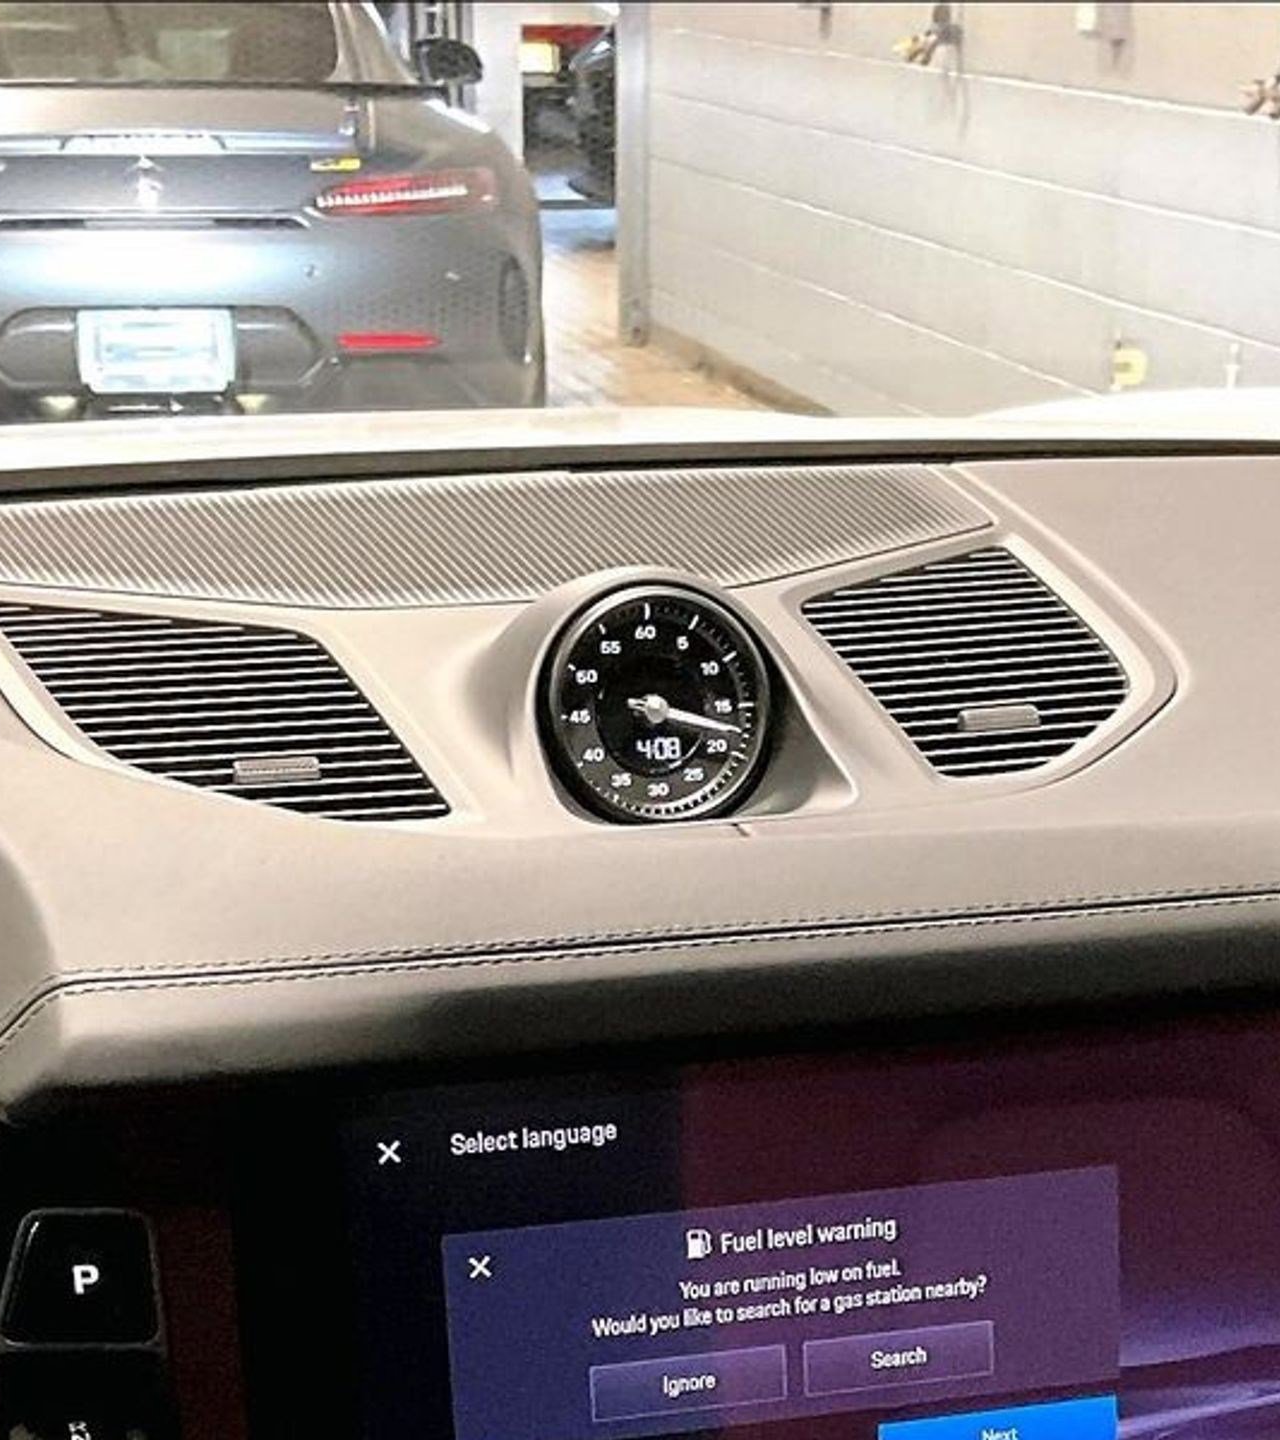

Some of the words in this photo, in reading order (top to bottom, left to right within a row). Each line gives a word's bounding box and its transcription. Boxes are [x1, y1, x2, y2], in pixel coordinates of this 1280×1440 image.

[635, 626, 656, 639] 60
[600, 641, 621, 654] 55
[677, 637, 689, 650] 5
[700, 662, 719, 675] 10
[714, 700, 732, 713] 15
[570, 710, 590, 724] 45
[707, 739, 727, 753] 20
[583, 749, 604, 761] 40
[611, 774, 631, 787] 35
[683, 768, 703, 781] 25
[648, 783, 669, 796] 30
[450, 1132, 519, 1156] Select
[522, 1123, 618, 1151] language
[720, 1228, 764, 1254] Fuel
[767, 1223, 813, 1249] level
[816, 1217, 897, 1244] warning
[72, 1264, 99, 1294] P
[679, 1279, 711, 1301] You
[714, 1281, 740, 1298] are
[743, 1269, 807, 1294] running
[809, 1266, 839, 1286] low
[842, 1266, 863, 1282] on
[865, 1258, 901, 1279] fuel.
[592, 1315, 647, 1339] Would
[649, 1314, 680, 1337] you
[683, 1307, 713, 1327] like
[715, 1306, 734, 1324] to
[736, 1298, 791, 1323] search
[793, 1295, 819, 1315] for
[820, 1297, 831, 1312] a
[833, 1292, 862, 1313] gas
[865, 1282, 921, 1307] station
[924, 1274, 987, 1300] nearby?
[870, 1346, 927, 1370] Search
[663, 1373, 716, 1398] Ignore
